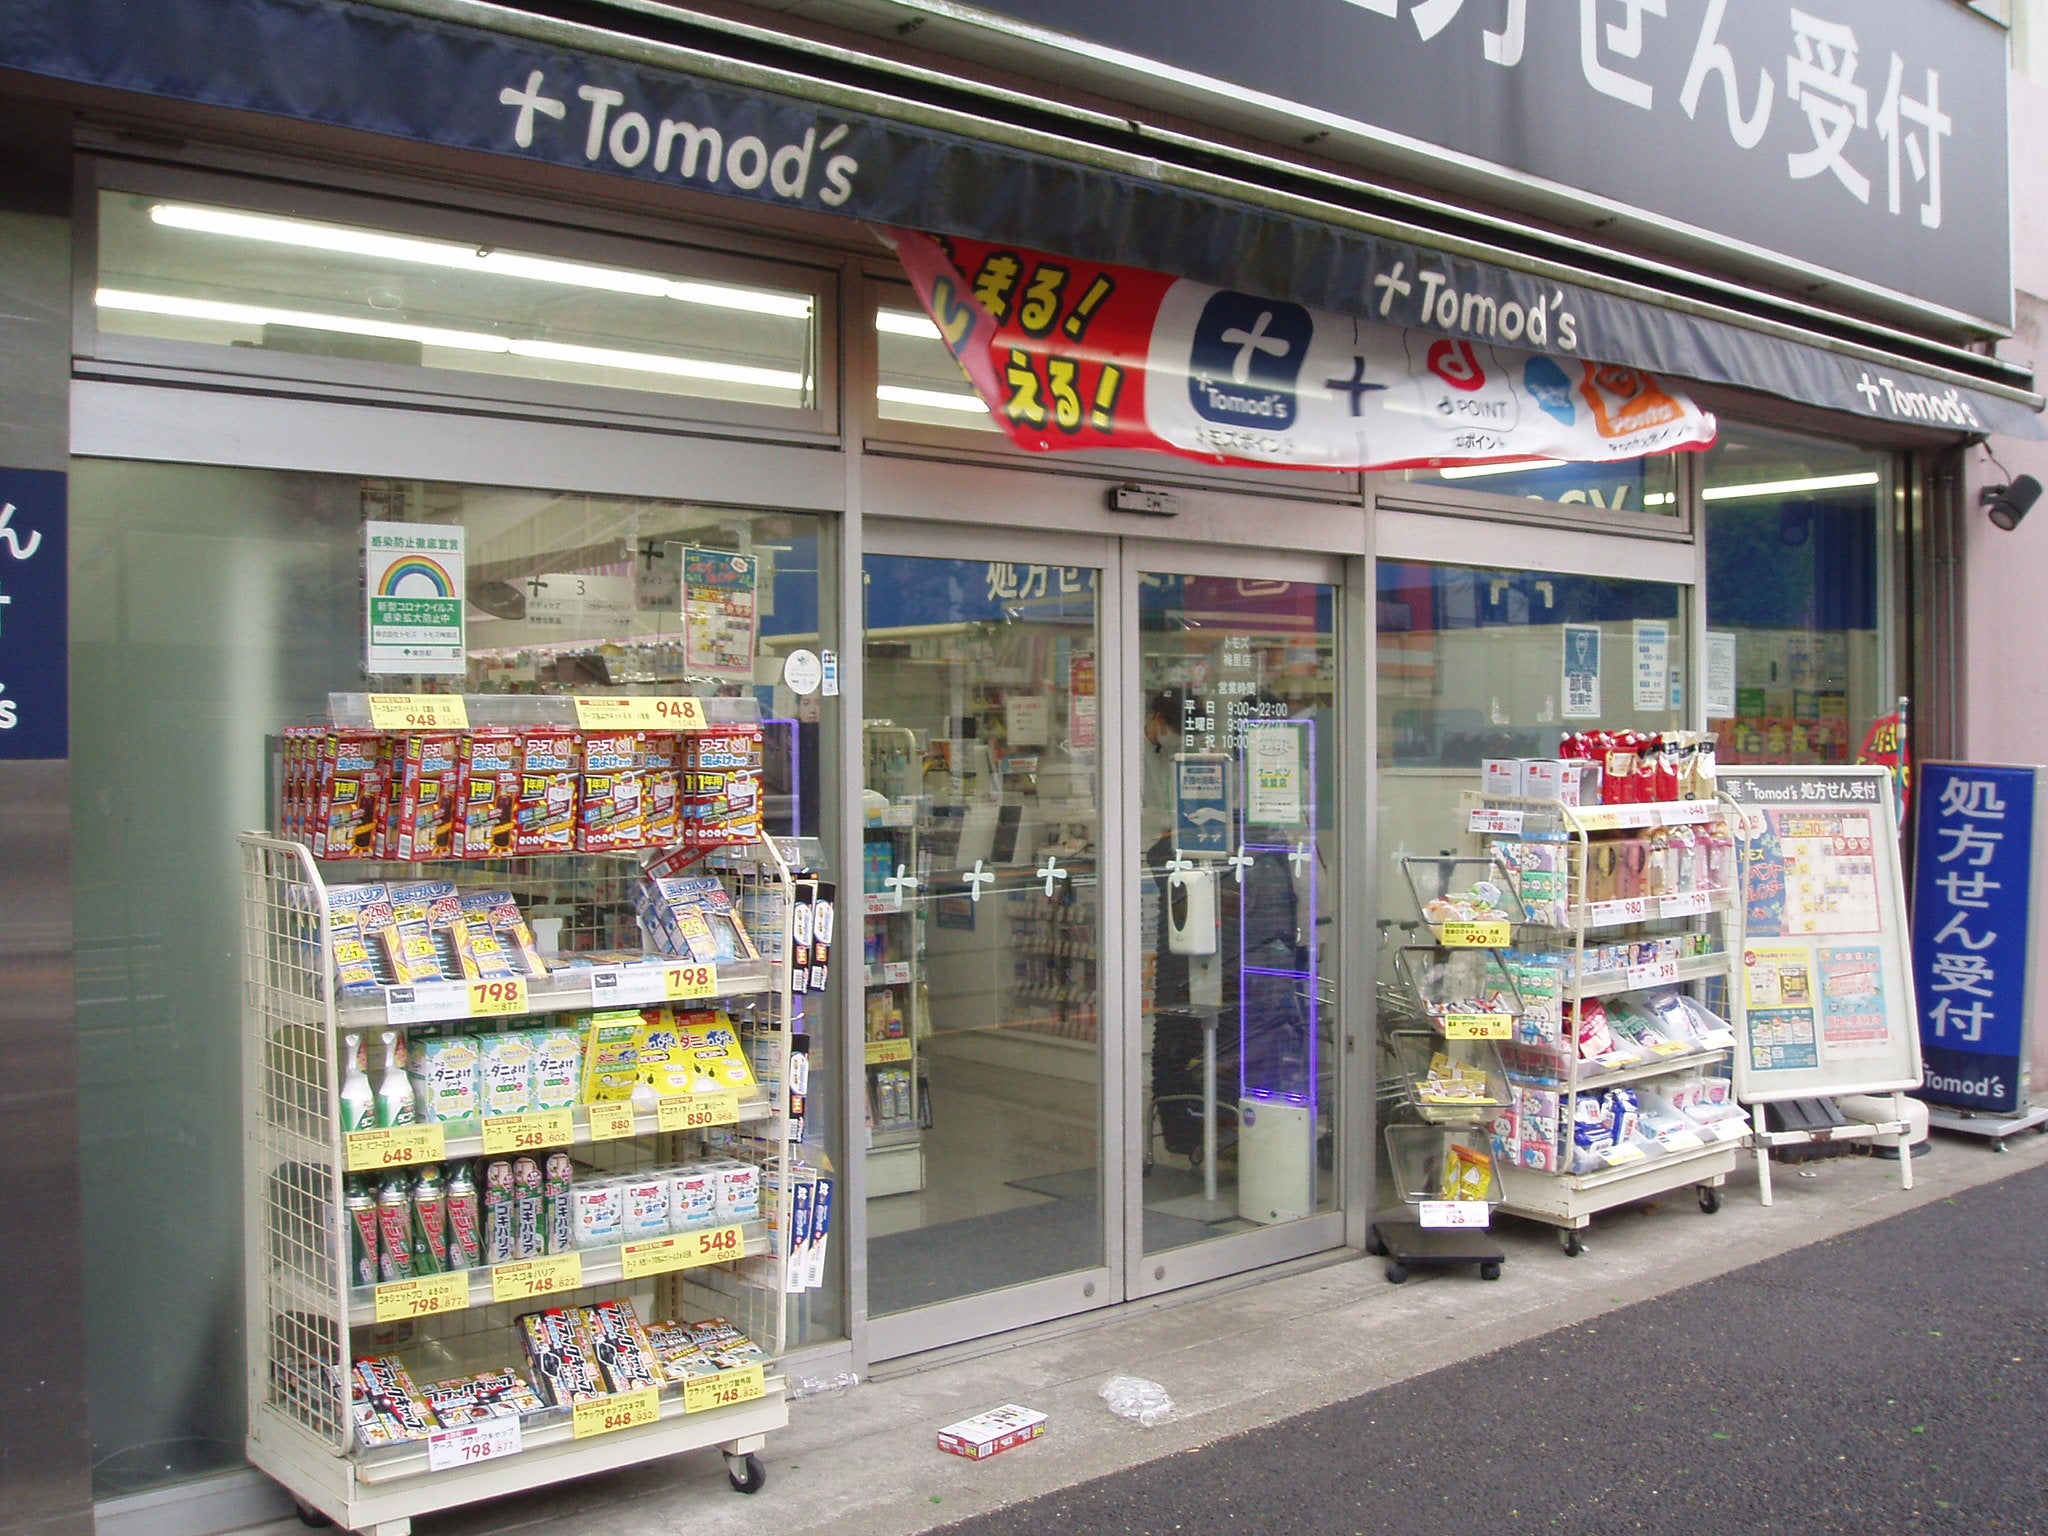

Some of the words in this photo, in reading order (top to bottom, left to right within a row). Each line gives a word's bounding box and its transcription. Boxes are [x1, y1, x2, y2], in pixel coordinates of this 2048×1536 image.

[578, 84, 859, 206] Tomod's
[1419, 271, 1577, 350] Tomod's
[1207, 386, 1288, 419] Tomod's
[1880, 378, 1979, 428] Tomod's
[576, 580, 585, 596] 3
[986, 563, 1097, 601] 処方せ
[377, 602, 456, 612] 新型コロナウイルス
[1224, 635, 1250, 650] トモズ
[656, 701, 696, 718] 948
[1206, 701, 1215, 714] 日
[406, 714, 437, 726] 948
[527, 740, 552, 755] アース
[588, 740, 614, 755] アース
[701, 740, 728, 753] アース
[1185, 735, 1194, 747] 日
[587, 755, 632, 770] 虫よけネット
[700, 754, 748, 769] 虫よけネット
[1754, 786, 1798, 800] Tomod's
[1801, 781, 1876, 799] 処方せん受付
[1487, 821, 1504, 831] 198
[437, 899, 458, 913] 260
[1691, 894, 1706, 905] 799
[368, 904, 388, 918] 260
[498, 905, 516, 918] 260
[868, 904, 885, 912] 980
[1625, 902, 1642, 914] 980
[1929, 776, 2005, 1042] 処方せん受付
[1466, 934, 1487, 944] 90
[669, 967, 709, 988] 798
[1659, 964, 1675, 977] 398
[474, 982, 518, 1003] 798
[693, 986, 709, 995] 877
[501, 1002, 518, 1011] 877
[1468, 1027, 1489, 1037] 98
[491, 1064, 527, 1077] ダニよけ
[539, 1058, 574, 1072] ダニよけ
[434, 1068, 472, 1081] ダニよけ
[1924, 1070, 2005, 1099] Tomod's
[611, 1120, 630, 1131] 880
[687, 1112, 713, 1126] 880
[515, 1132, 544, 1147] 548
[549, 1133, 566, 1142] 602
[383, 1148, 413, 1163] 648
[419, 1149, 437, 1157] 712
[699, 1229, 737, 1254] 548
[717, 1250, 737, 1260] 602
[525, 1278, 553, 1294] 748
[559, 1278, 576, 1288] 822
[408, 1297, 438, 1314] 798
[445, 1297, 462, 1307] 877
[713, 1388, 739, 1404] 748
[604, 1412, 632, 1429] 848
[461, 1442, 491, 1460] 798
